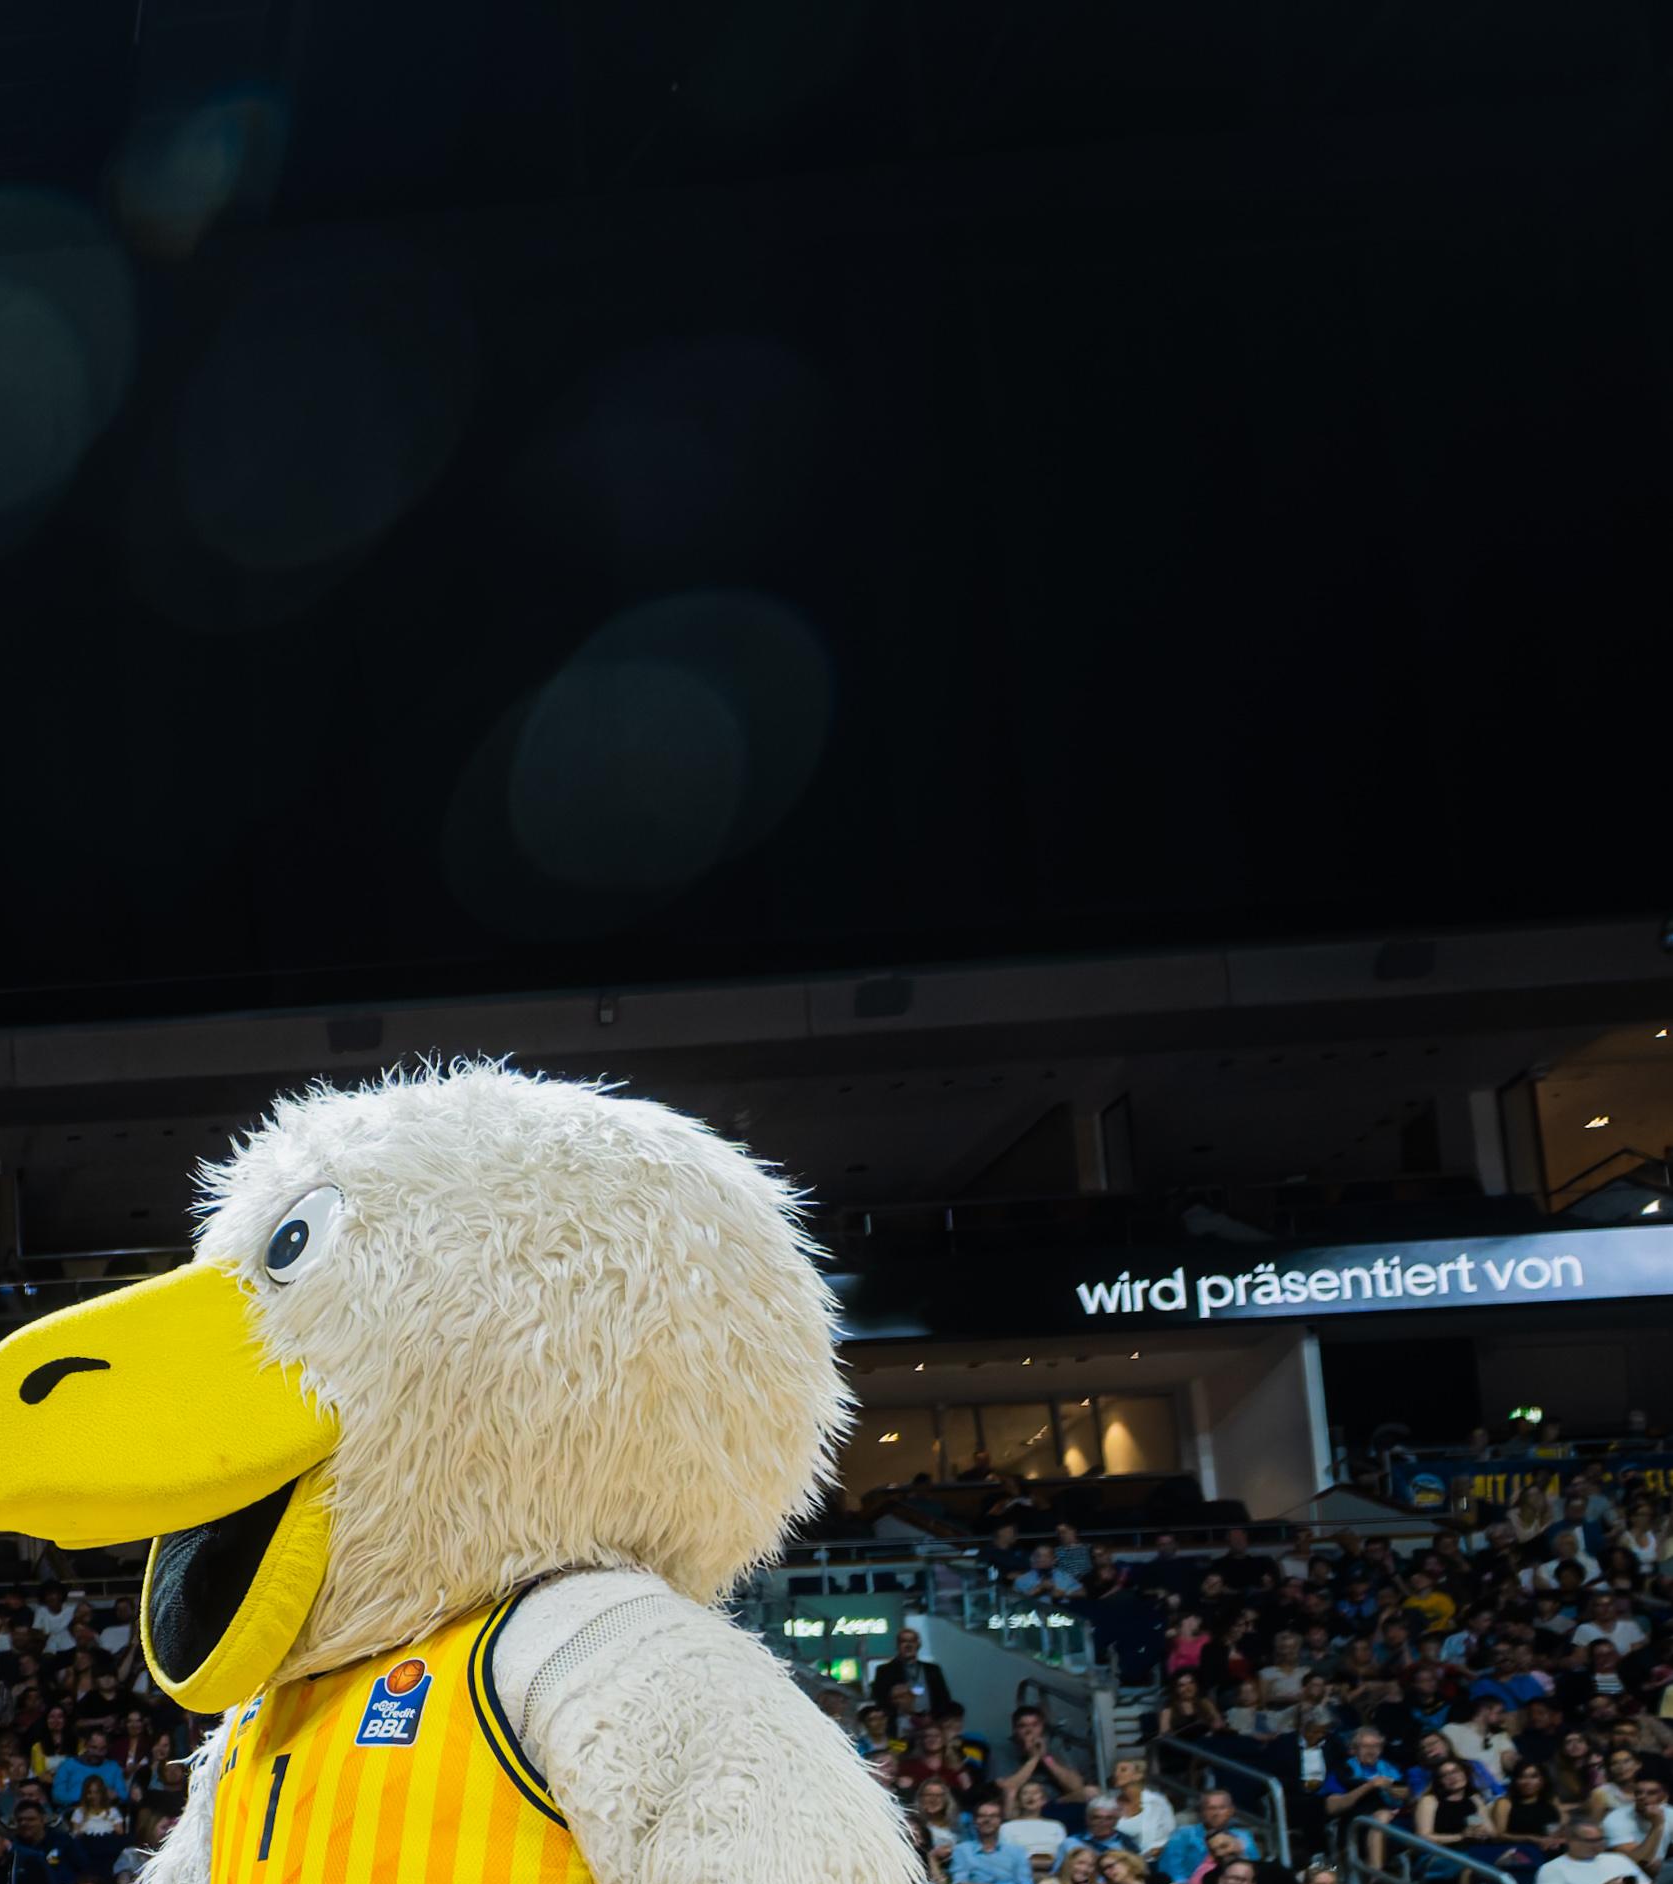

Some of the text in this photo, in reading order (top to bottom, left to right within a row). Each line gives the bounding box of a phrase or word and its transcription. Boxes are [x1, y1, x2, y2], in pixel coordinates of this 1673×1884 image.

[1075, 1252, 1585, 1319] wird präsentiert von
[362, 1718, 409, 1739] BBL
